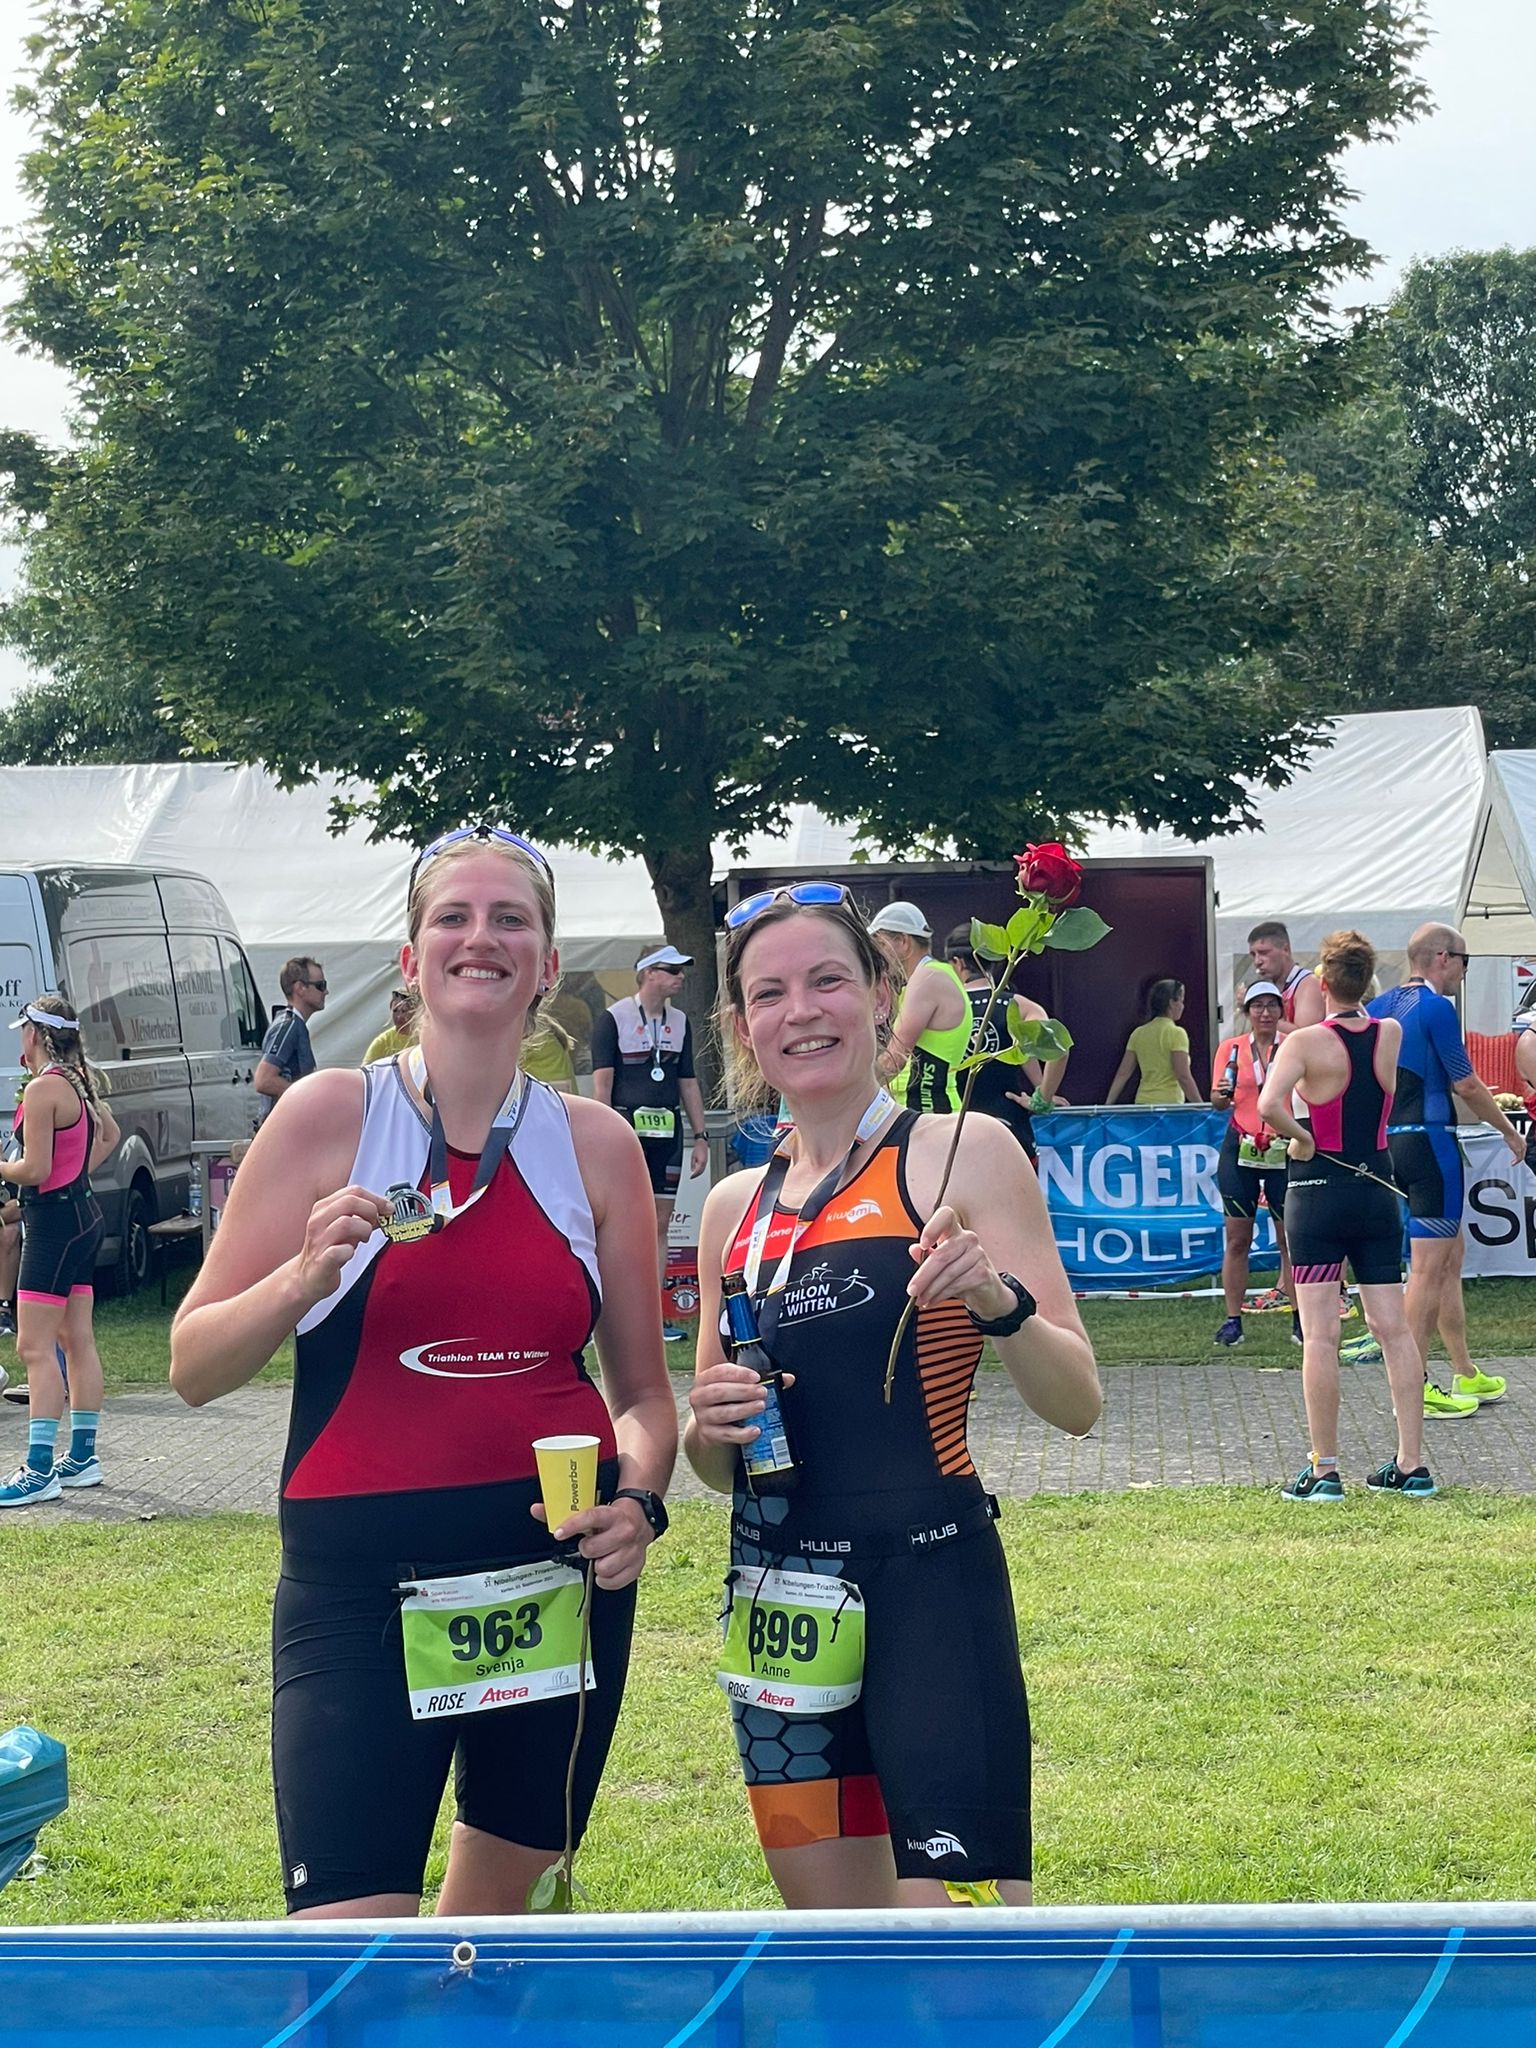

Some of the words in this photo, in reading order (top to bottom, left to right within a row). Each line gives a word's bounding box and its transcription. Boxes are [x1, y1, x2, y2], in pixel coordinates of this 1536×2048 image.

[640, 1115, 667, 1126] 1191
[786, 1296, 838, 1317] WITTEN
[428, 1353, 473, 1362] Triathlon
[477, 1352, 504, 1361] TEAM
[508, 1351, 520, 1360] TG
[523, 1350, 549, 1359] Witten
[569, 1458, 579, 1512] Powerbar
[735, 1521, 761, 1541] HUUB
[800, 1539, 852, 1552] HUUB
[448, 1602, 543, 1662] 963
[749, 1607, 818, 1662] 899
[476, 1657, 525, 1677] Svenja
[761, 1662, 791, 1678] Anne
[427, 1692, 466, 1713] ROSE
[478, 1686, 529, 1706] Atera
[728, 1681, 751, 1699] ROSE
[756, 1688, 795, 1707] Atera
